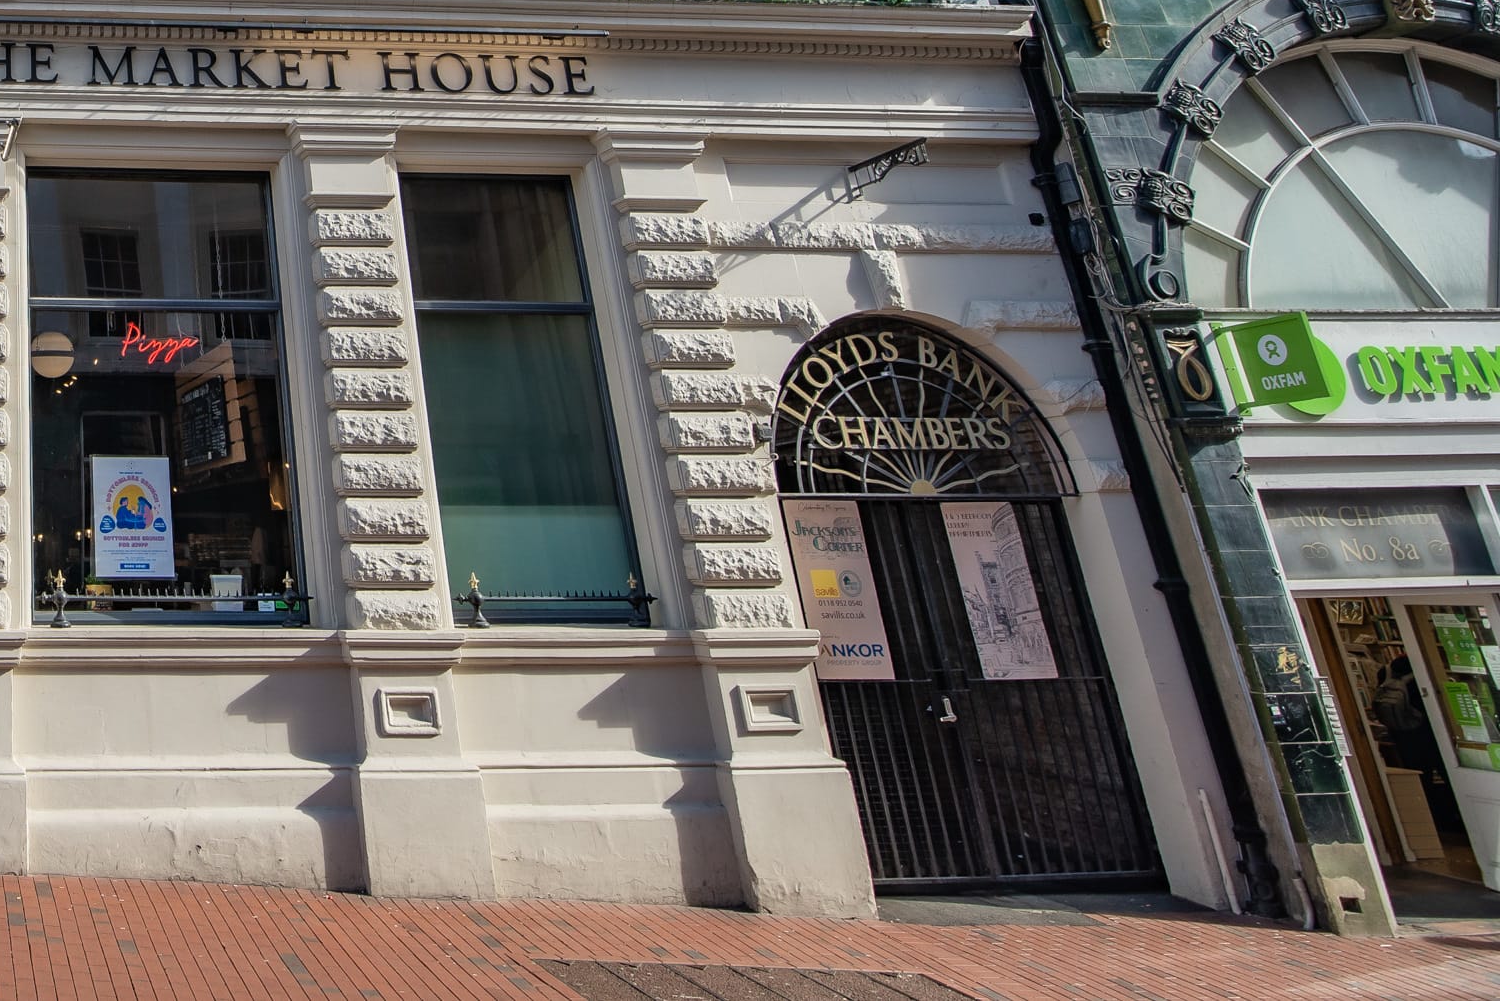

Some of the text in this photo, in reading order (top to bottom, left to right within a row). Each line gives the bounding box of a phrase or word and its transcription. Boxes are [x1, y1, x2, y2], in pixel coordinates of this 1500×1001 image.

[87, 46, 350, 90] MARKET
[376, 51, 595, 96] HOUSE
[121, 321, 200, 364] Pizza
[777, 331, 1031, 426] LLOYDS BANK
[1260, 371, 1308, 391] OXFAM
[812, 416, 1011, 449] CHAMBERS
[1267, 504, 1467, 527] BANK CHAMBERS
[1339, 536, 1420, 562] No. 8a
[815, 588, 839, 597] savills
[821, 611, 865, 620] savills.co.uk
